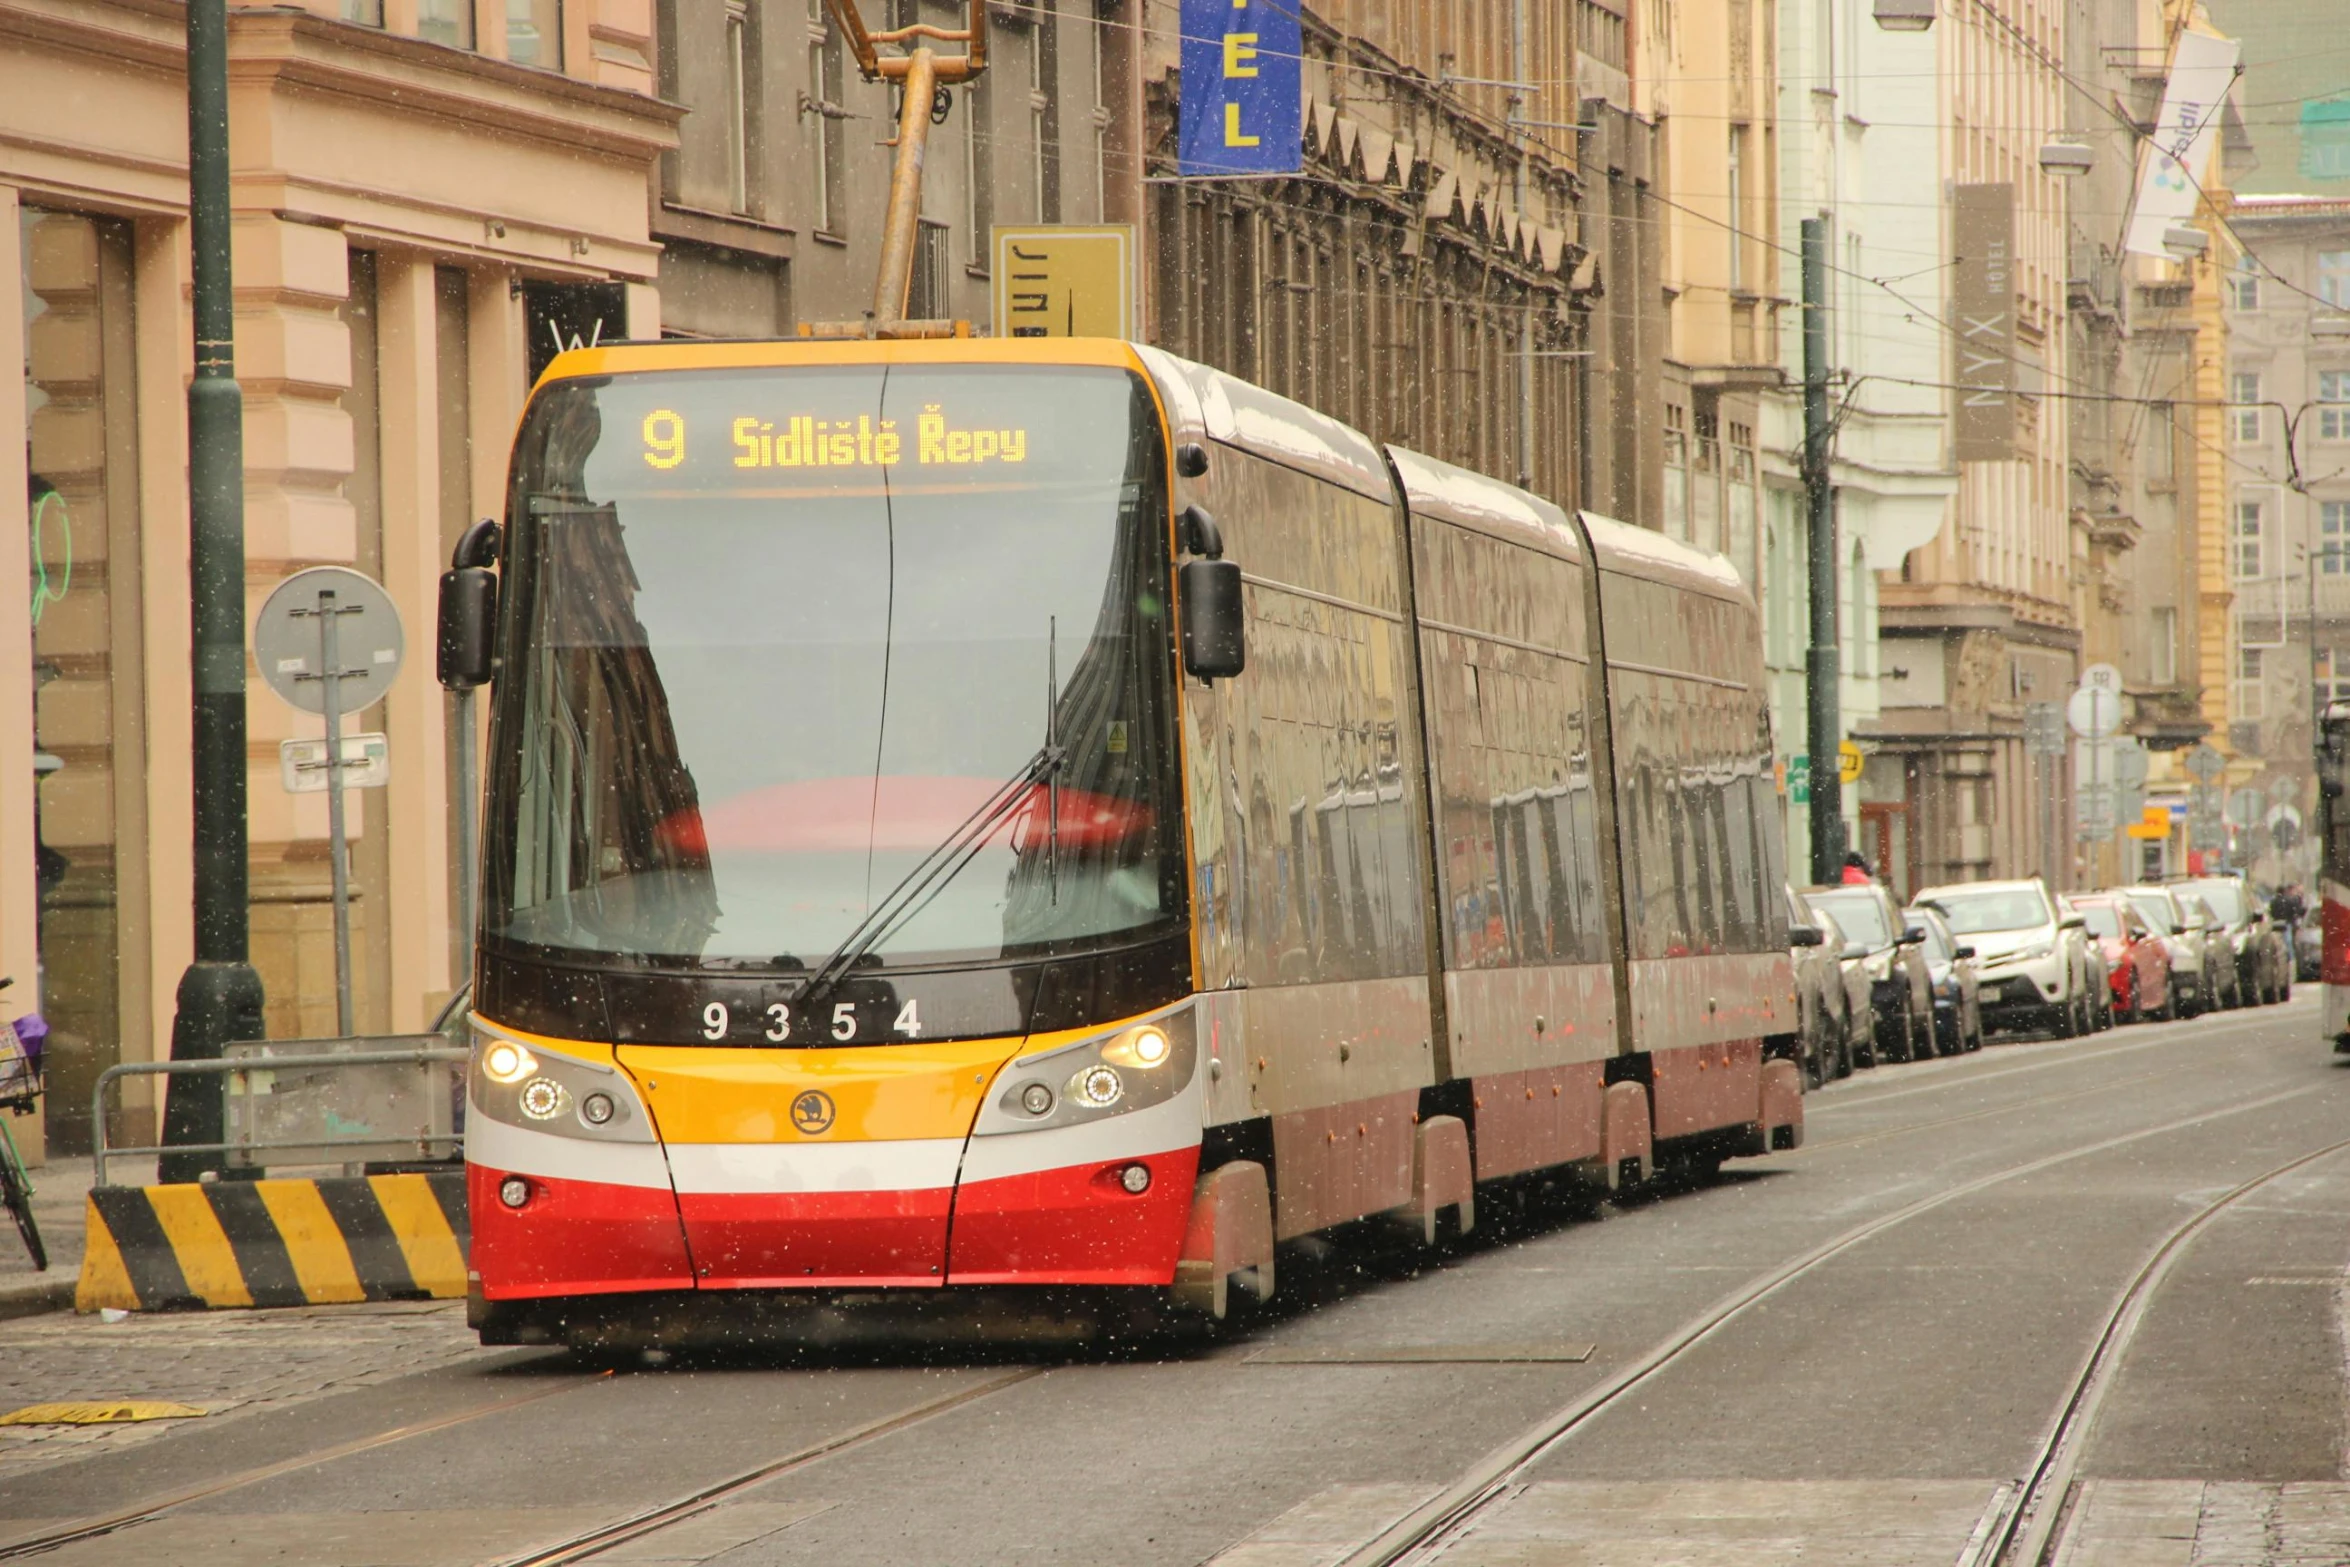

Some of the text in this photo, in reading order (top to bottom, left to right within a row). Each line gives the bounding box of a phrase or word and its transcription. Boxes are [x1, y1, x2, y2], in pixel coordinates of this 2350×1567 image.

[1223, 0, 1260, 147] EL
[549, 318, 603, 352] W
[1963, 239, 2005, 406] NYX HOTEL
[643, 404, 1025, 469] 9 Sídliště Řepy
